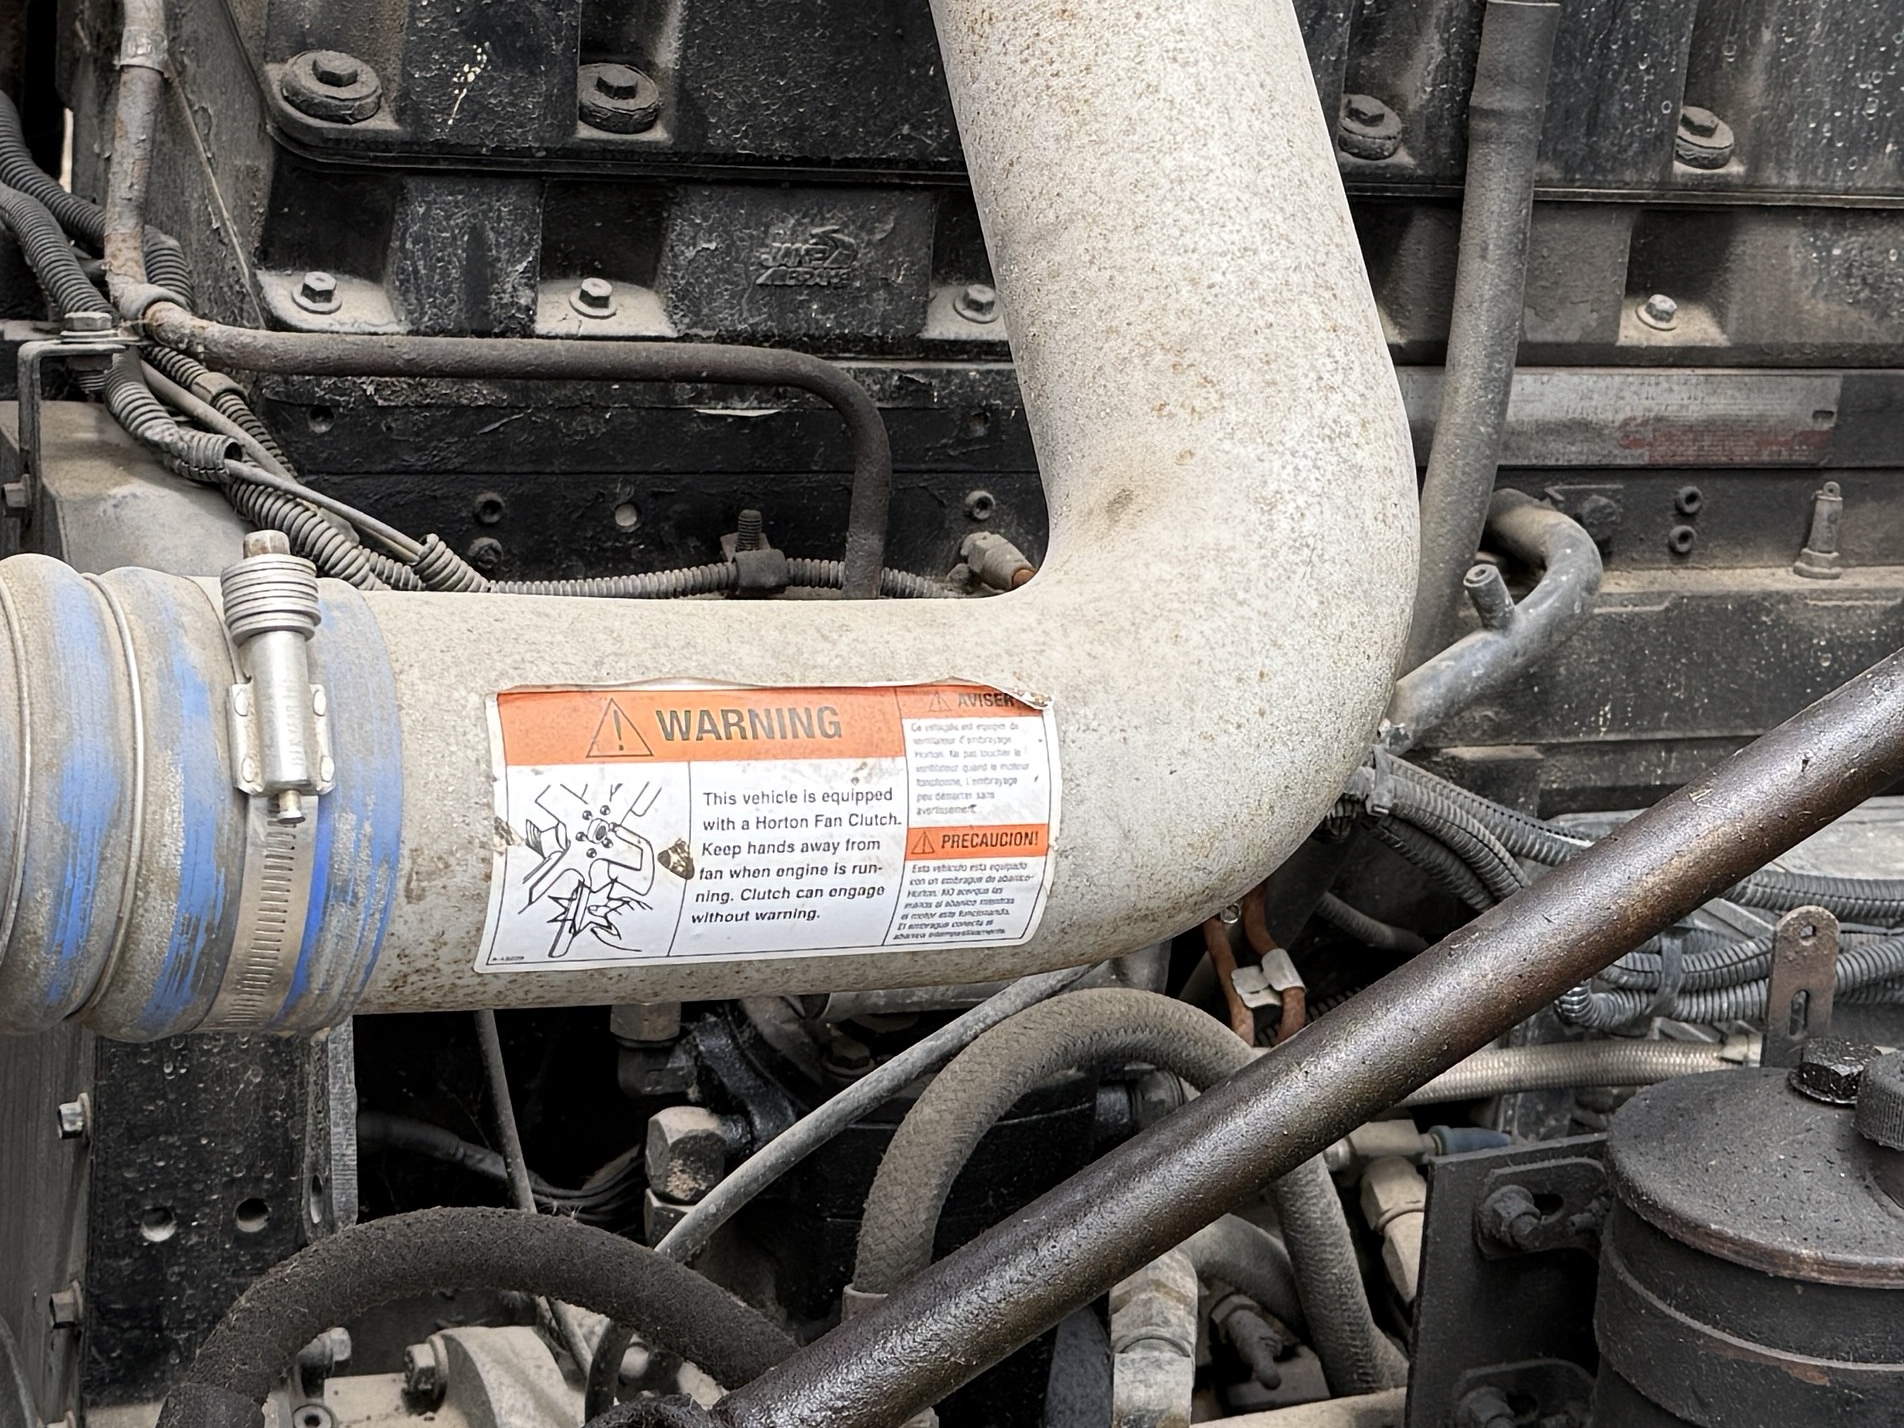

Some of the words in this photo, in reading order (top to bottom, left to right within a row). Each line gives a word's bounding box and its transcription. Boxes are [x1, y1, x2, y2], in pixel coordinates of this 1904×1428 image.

[656, 706, 842, 742] WARNING
[702, 791, 737, 806] This
[742, 790, 798, 805] vehicle
[803, 789, 817, 804] is
[821, 787, 893, 806] equipped
[703, 817, 736, 832] with
[741, 819, 750, 831] a
[755, 815, 809, 830] Horton
[814, 814, 843, 828] Fan
[848, 812, 902, 827] Clutch.
[701, 842, 742, 859] Keep
[747, 839, 795, 855] hands
[800, 841, 841, 856] away
[845, 838, 881, 852] from
[941, 831, 1038, 849] PRECAUCION!
[699, 867, 724, 881] fan
[729, 865, 771, 879] when
[776, 863, 829, 880] engine
[833, 862, 847, 875] is
[851, 864, 883, 875] run-
[695, 889, 734, 905] ning.
[740, 886, 789, 902] Clutch
[795, 888, 824, 899] can
[828, 885, 885, 900] engage
[691, 910, 750, 924] without
[755, 908, 820, 922] warning.
